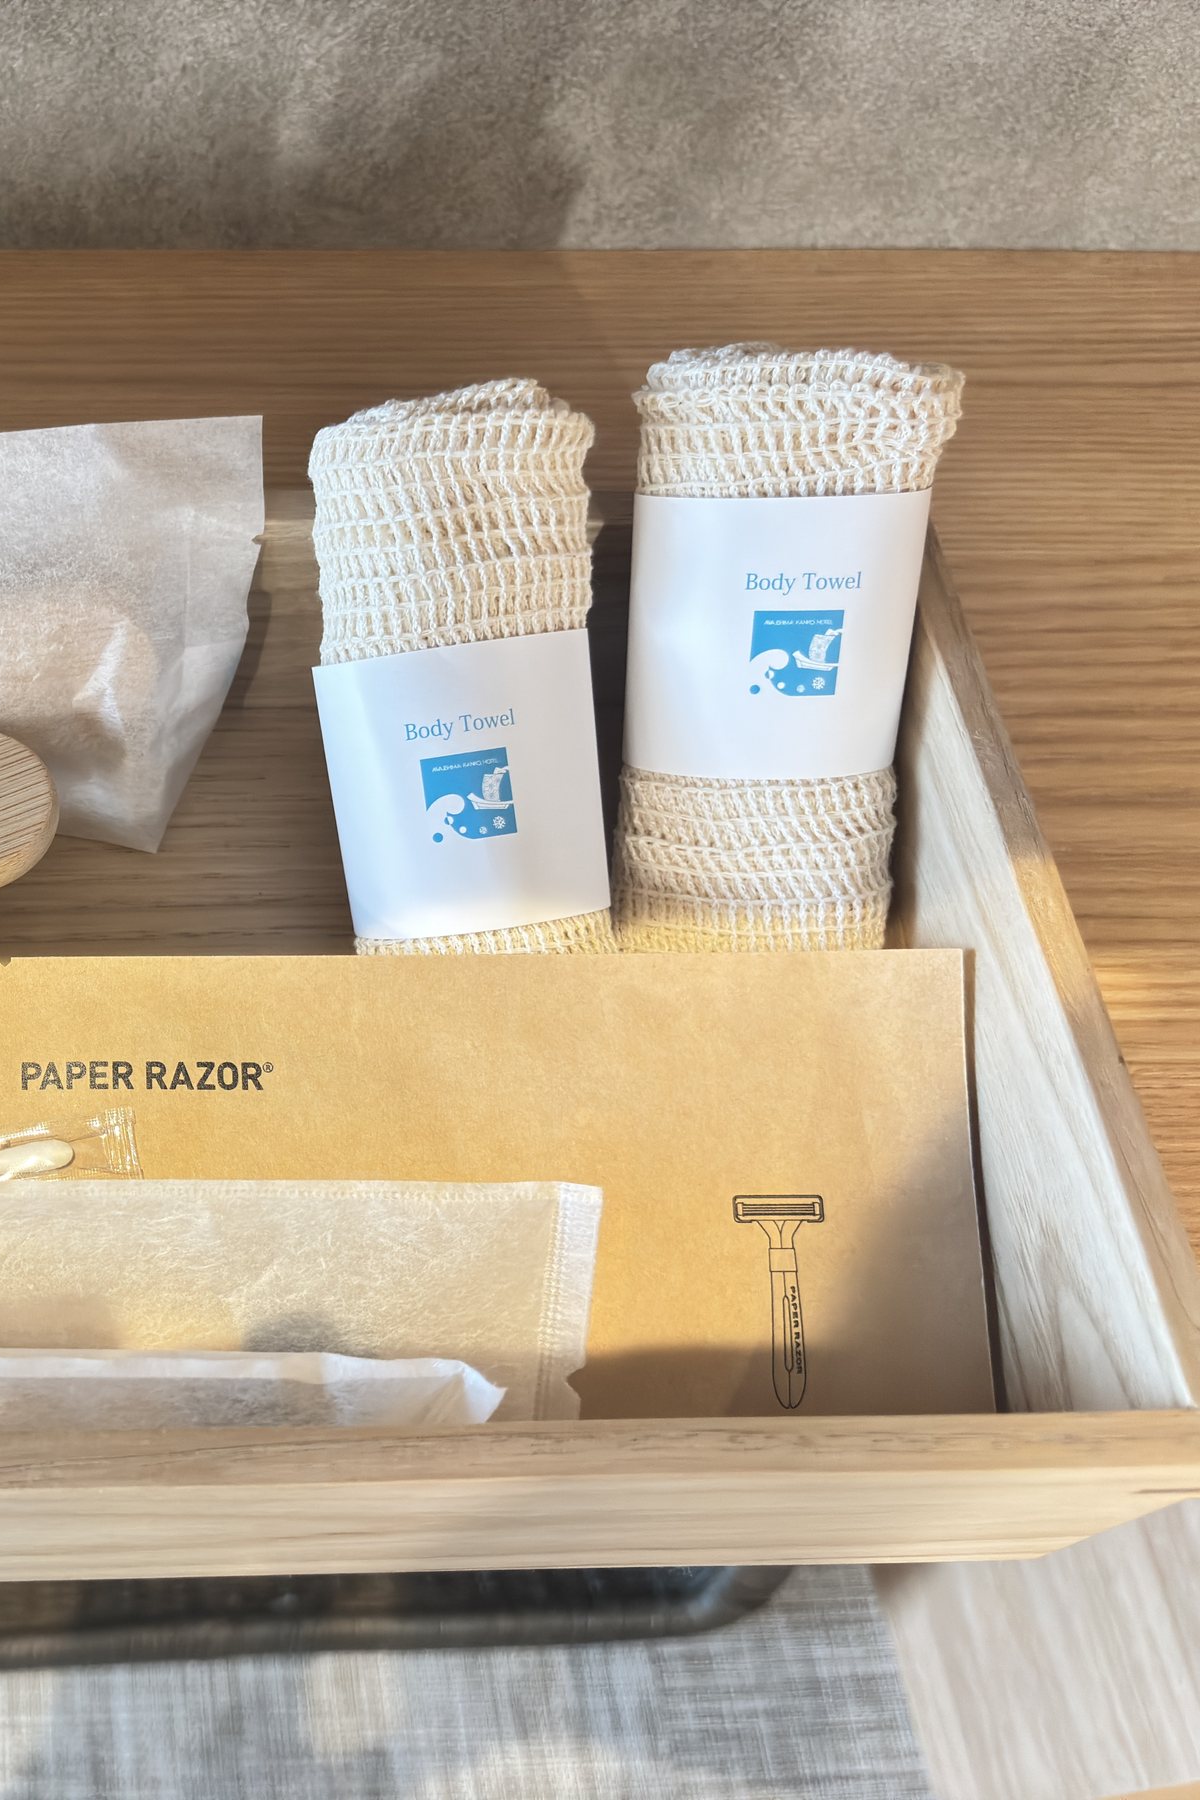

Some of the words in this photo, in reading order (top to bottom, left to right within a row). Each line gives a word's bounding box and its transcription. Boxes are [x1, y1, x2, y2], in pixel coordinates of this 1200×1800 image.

[745, 572, 796, 596] Body
[801, 571, 862, 590] Towel
[403, 718, 454, 741] Body
[459, 707, 516, 733] Towel
[20, 1061, 135, 1091] PAPER
[790, 1285, 799, 1329] PAPER
[794, 1331, 803, 1375] RAZOR
